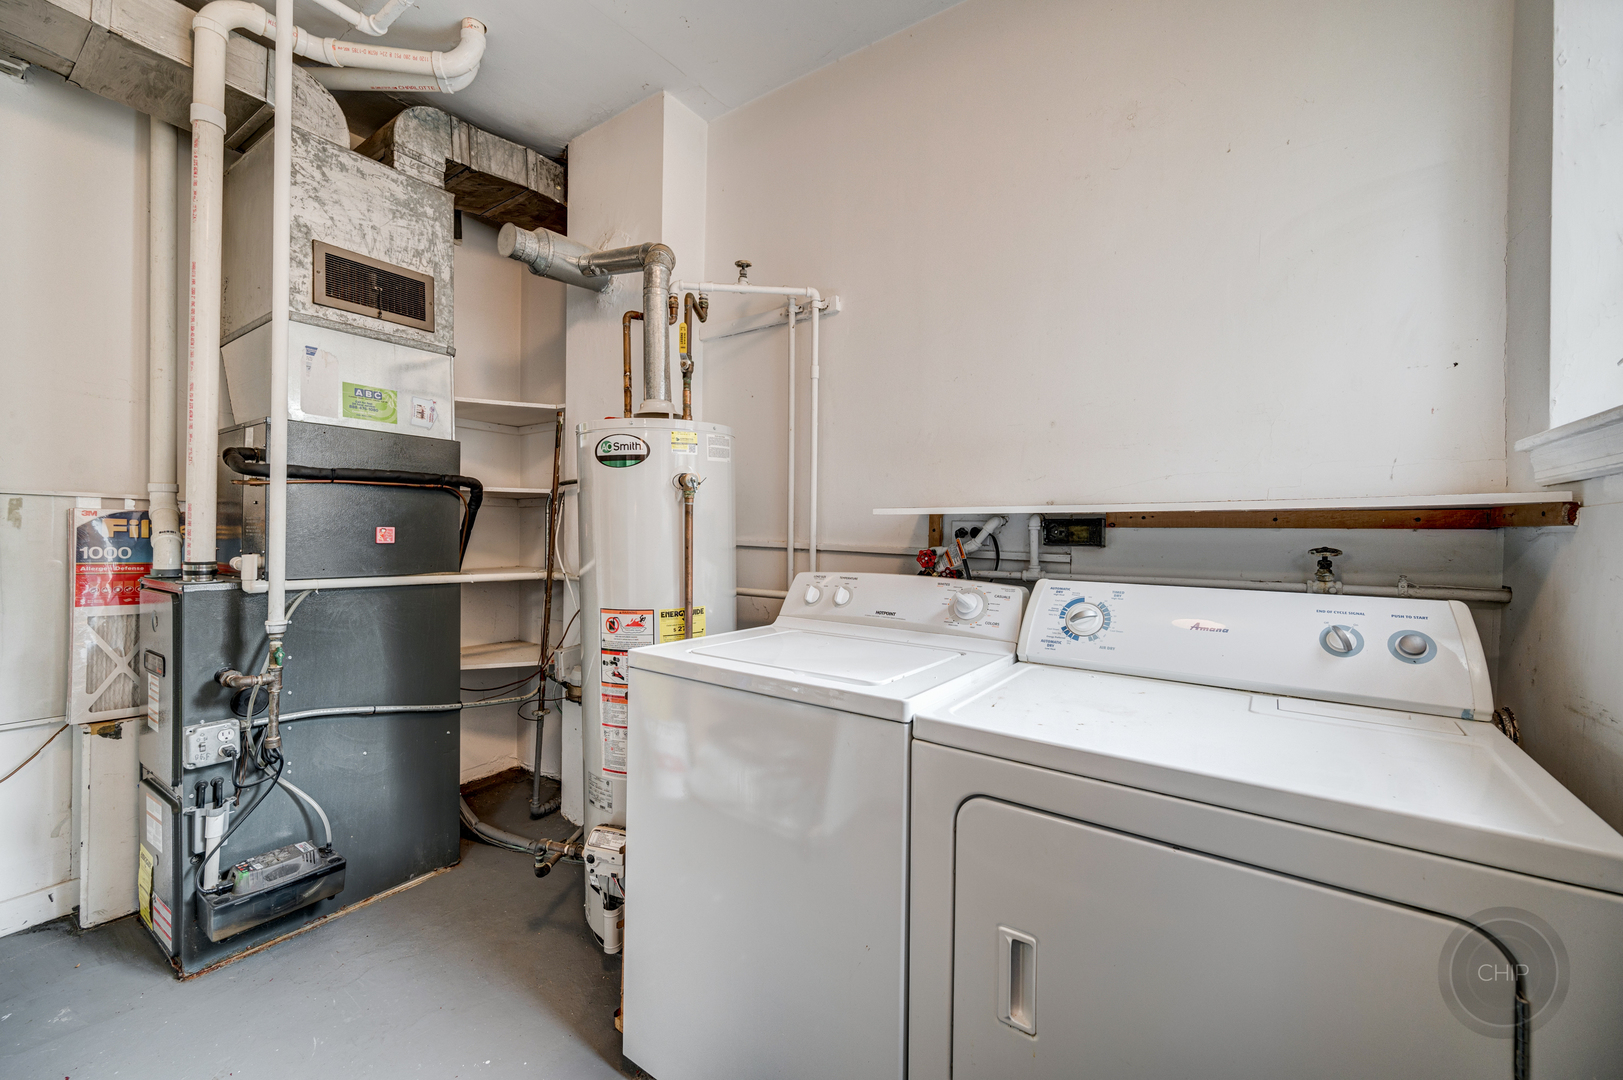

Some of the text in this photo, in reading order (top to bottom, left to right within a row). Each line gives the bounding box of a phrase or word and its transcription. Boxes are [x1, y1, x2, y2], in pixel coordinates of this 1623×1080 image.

[355, 389, 382, 400] ABC
[80, 546, 132, 559] 1000
[1190, 622, 1229, 633] Amana
